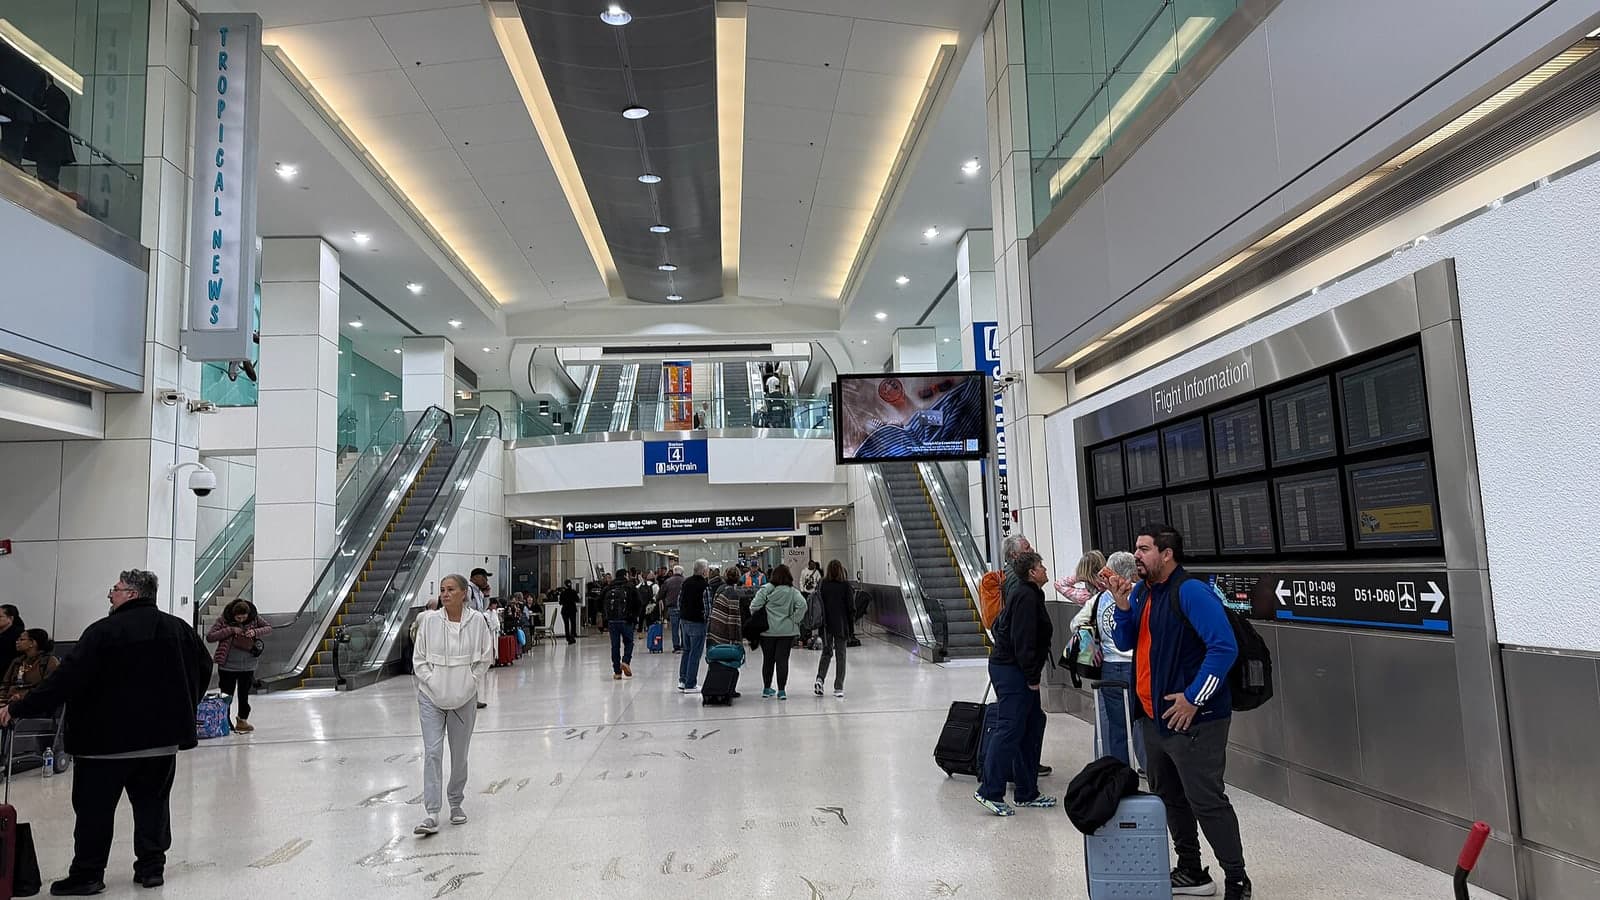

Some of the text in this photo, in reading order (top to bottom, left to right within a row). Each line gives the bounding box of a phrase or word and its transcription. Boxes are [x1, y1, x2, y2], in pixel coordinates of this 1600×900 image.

[207, 26, 229, 325] TROPICAL NEWS
[1154, 361, 1250, 414] Flight Information
[672, 448, 681, 461] 4
[666, 462, 697, 472] skytrain
[1308, 581, 1336, 592] D1-D49
[1310, 595, 1337, 607] E1-E33
[1354, 588, 1396, 603] D51-D60
